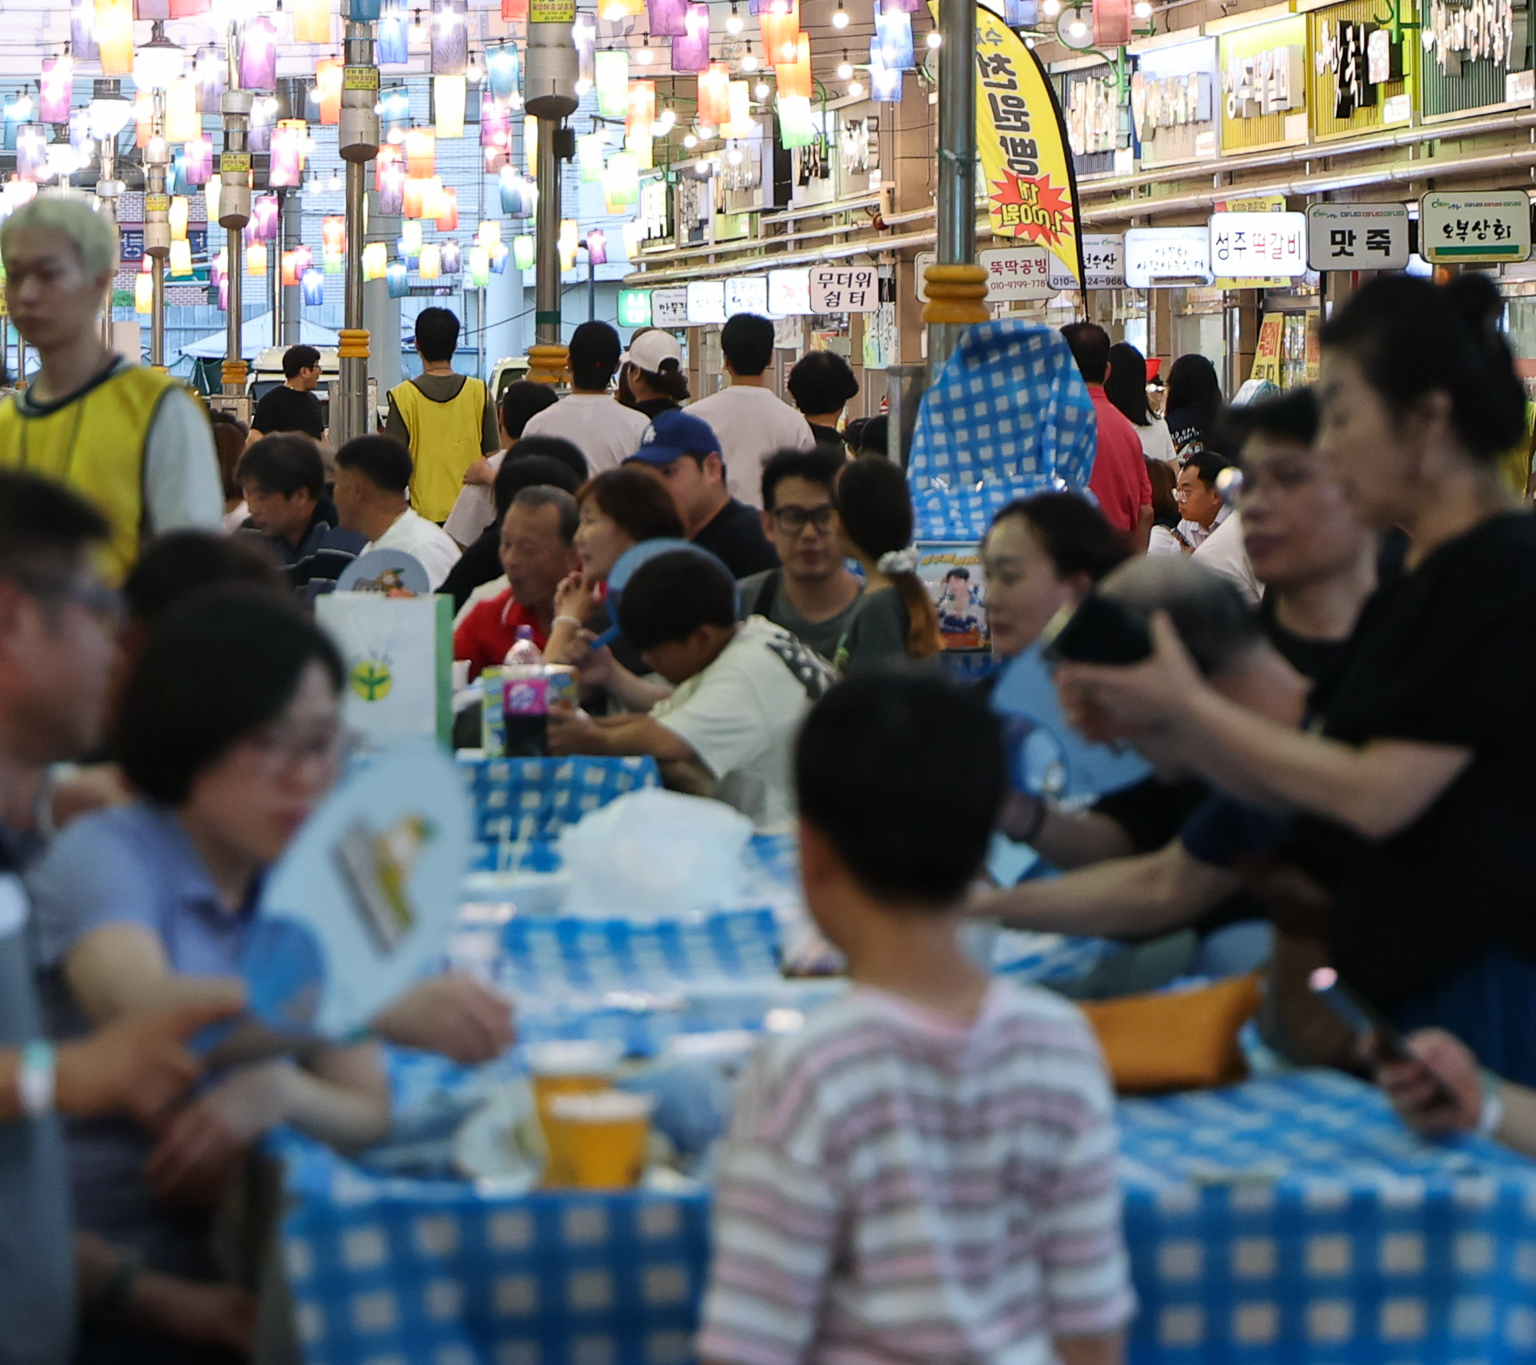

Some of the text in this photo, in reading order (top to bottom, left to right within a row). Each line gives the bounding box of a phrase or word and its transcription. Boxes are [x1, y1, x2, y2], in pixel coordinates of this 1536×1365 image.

[1216, 230, 1301, 261] 성주 떡갈비
[817, 271, 872, 287] 무더위
